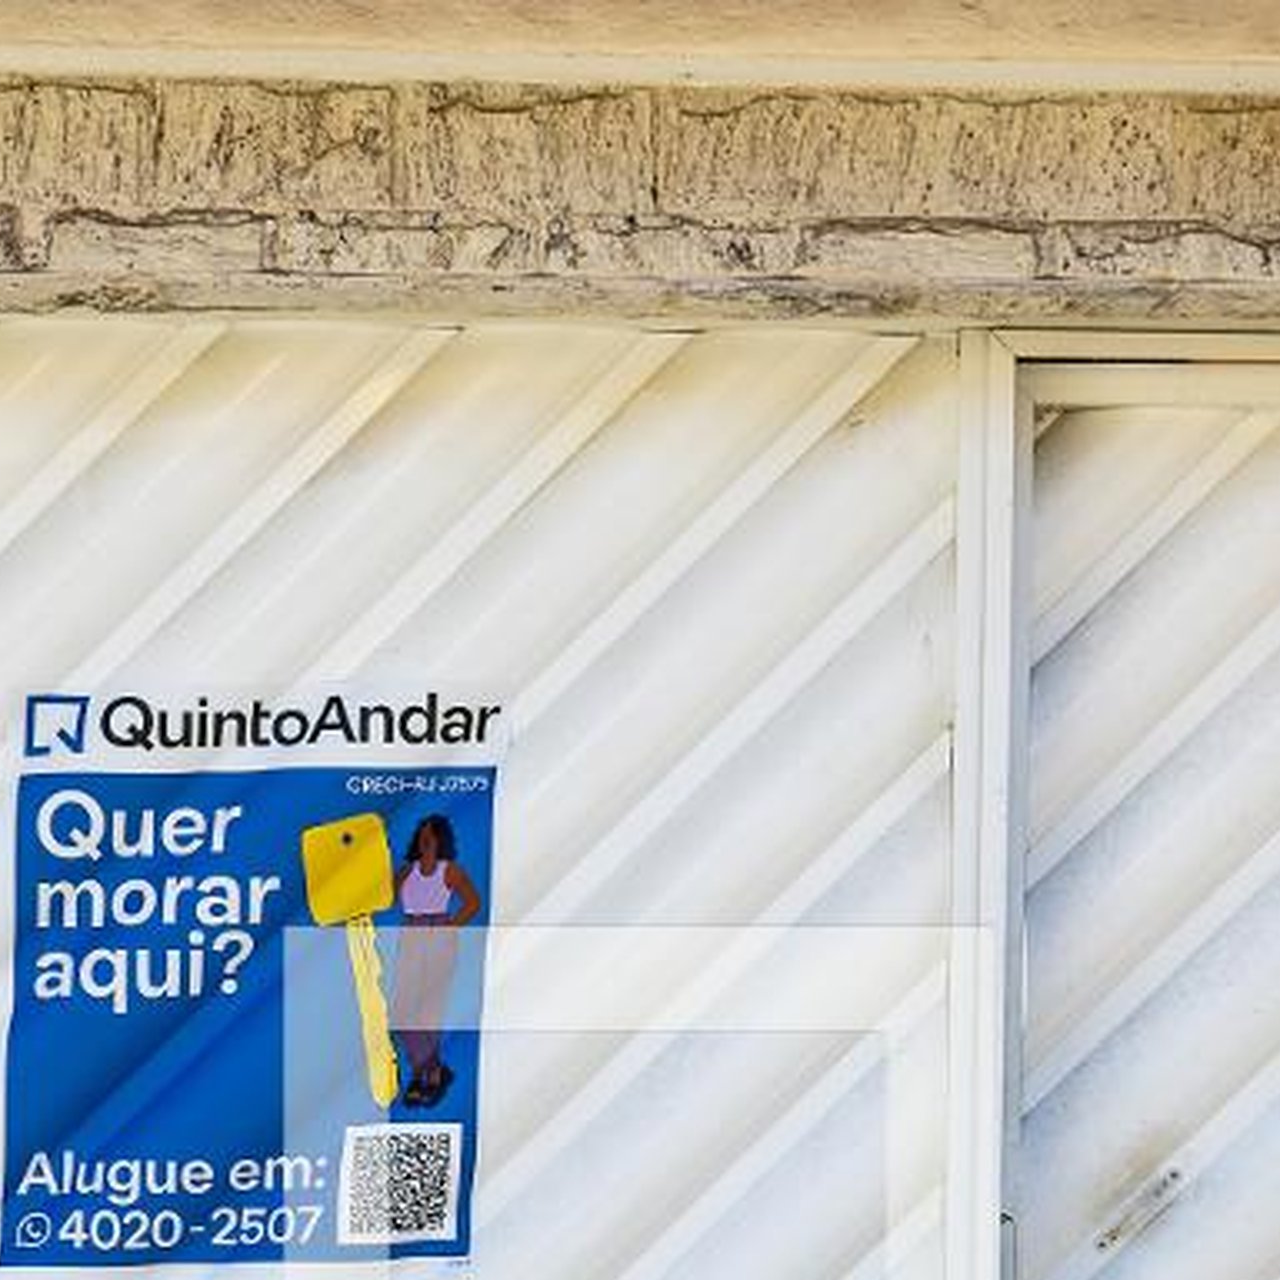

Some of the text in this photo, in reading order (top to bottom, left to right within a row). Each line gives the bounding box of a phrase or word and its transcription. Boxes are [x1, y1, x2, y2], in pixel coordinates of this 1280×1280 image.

[100, 693, 500, 751] QuintoAndar
[36, 789, 242, 860] Quer
[36, 875, 280, 928] morar
[33, 929, 255, 1014] aqui?
[16, 1151, 328, 1205] Alugue em:
